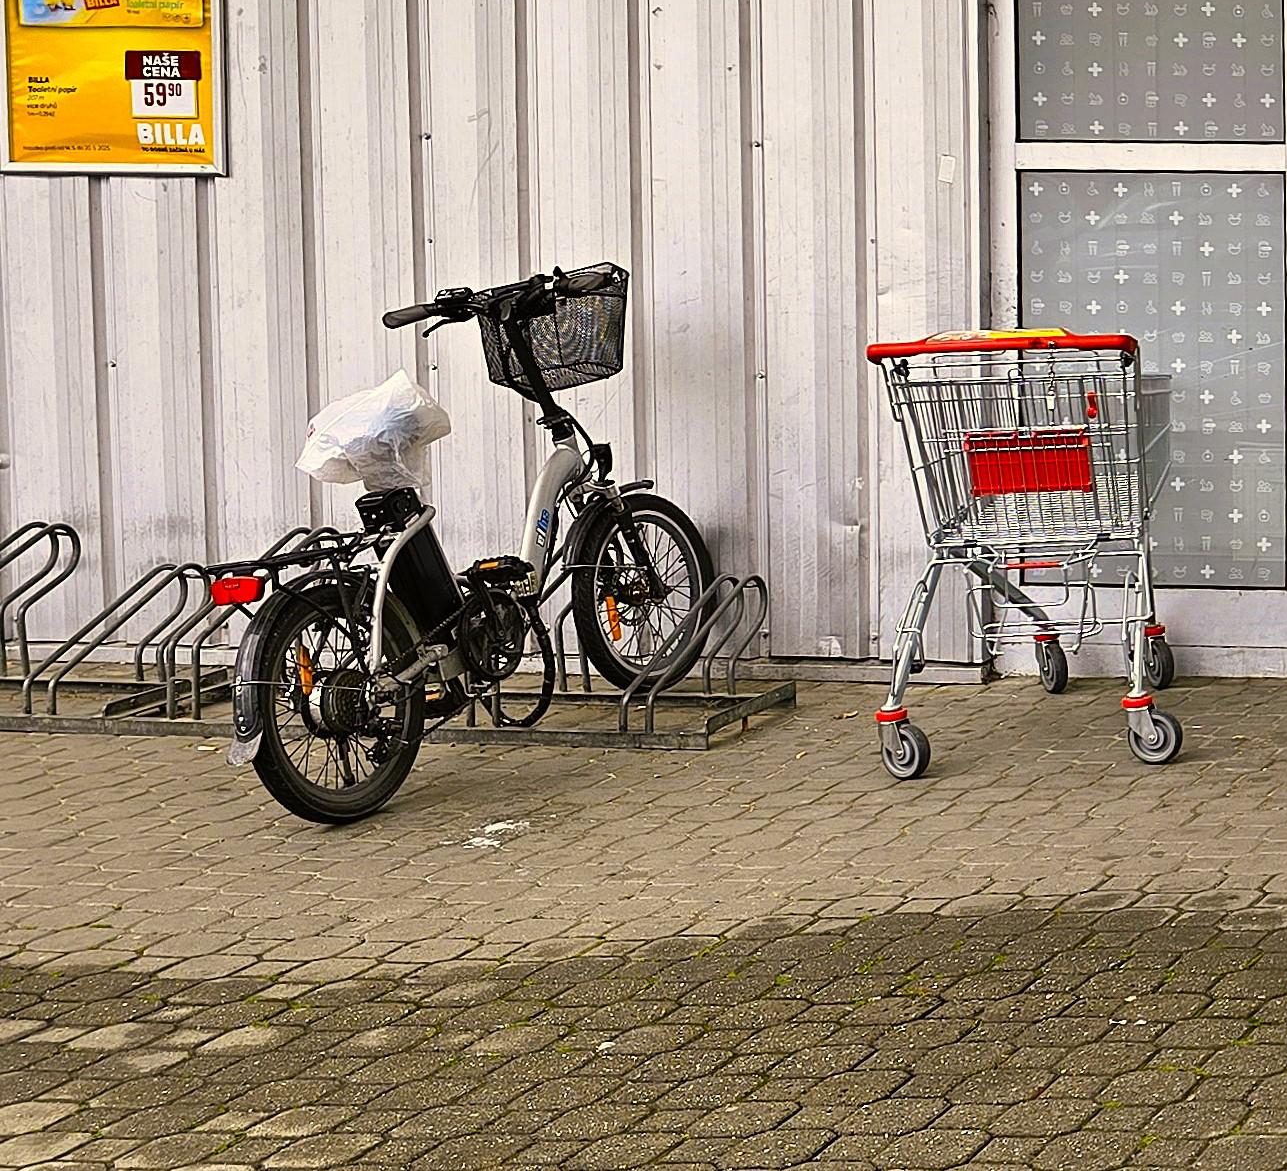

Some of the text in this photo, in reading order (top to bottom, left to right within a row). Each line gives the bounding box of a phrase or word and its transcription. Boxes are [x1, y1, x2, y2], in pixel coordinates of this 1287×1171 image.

[158, 0, 185, 10] papír
[142, 51, 180, 67] NAŠE
[142, 66, 181, 78] CENA
[28, 76, 50, 84] BILLA
[136, 123, 206, 146] BILLA
